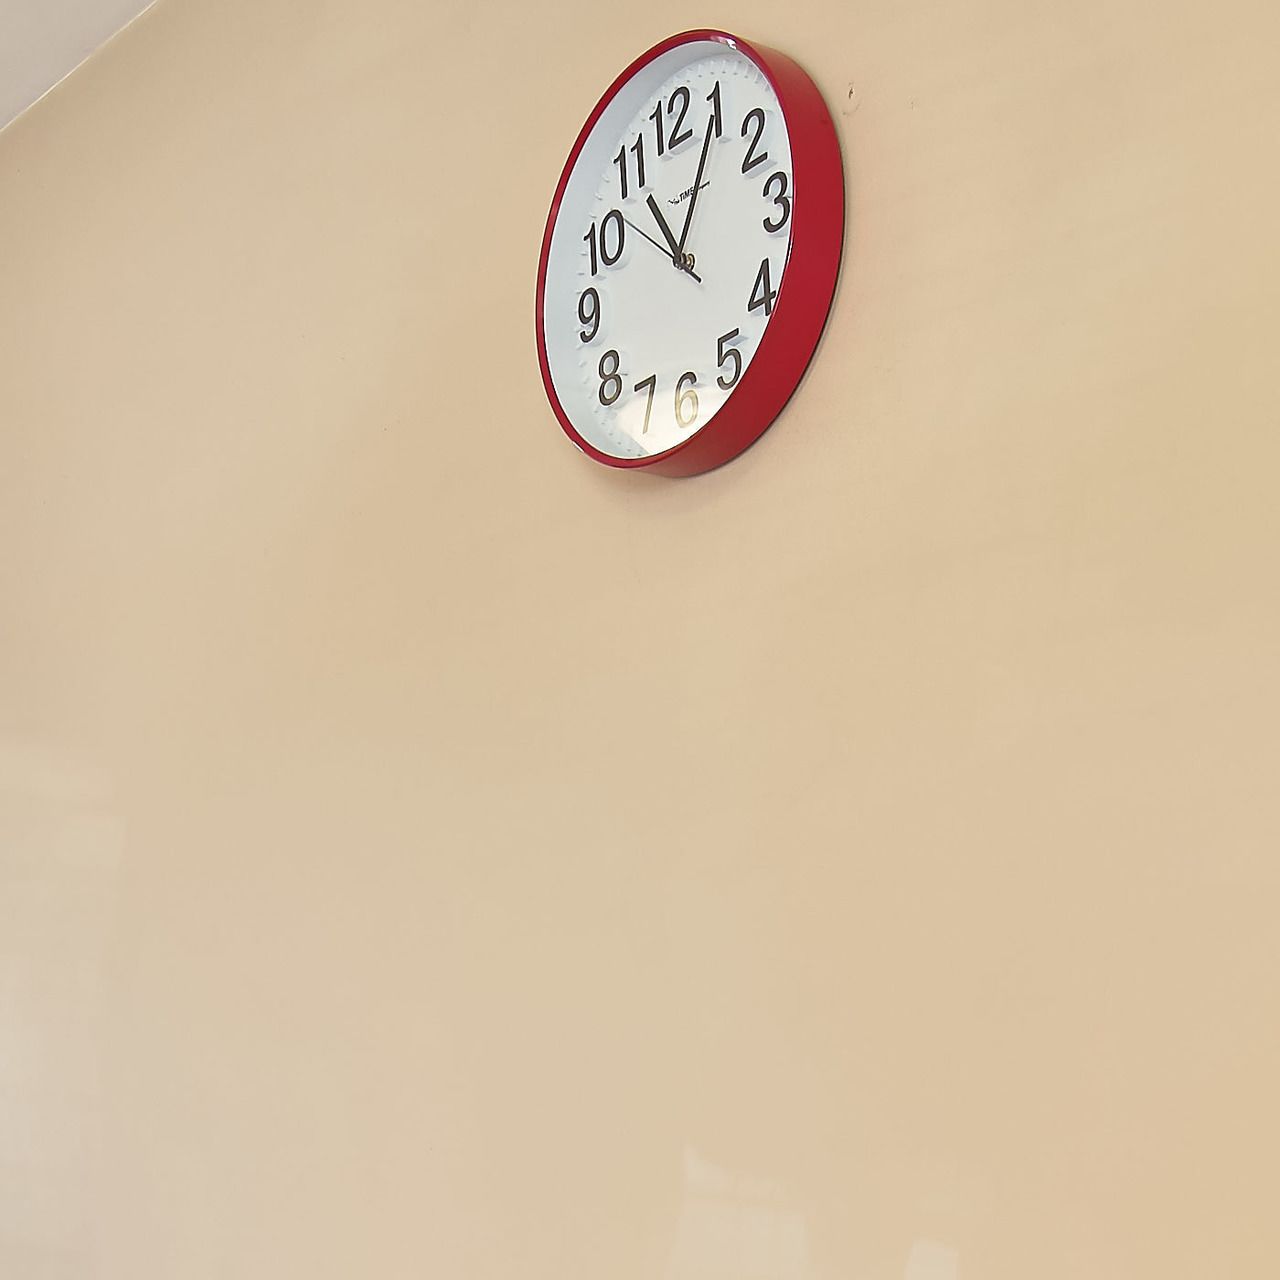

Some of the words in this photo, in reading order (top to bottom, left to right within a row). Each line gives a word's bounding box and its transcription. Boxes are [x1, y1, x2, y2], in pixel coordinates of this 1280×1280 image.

[650, 86, 693, 156] 12
[706, 80, 723, 138] 1
[613, 132, 645, 199] 11
[740, 108, 768, 174] 2
[762, 171, 791, 234] 3
[583, 209, 624, 277] 10
[578, 287, 601, 343] 9
[747, 257, 777, 317] 4
[598, 350, 622, 407] 8
[717, 328, 742, 391] 5
[634, 374, 657, 434] 7
[674, 372, 699, 431] 6
